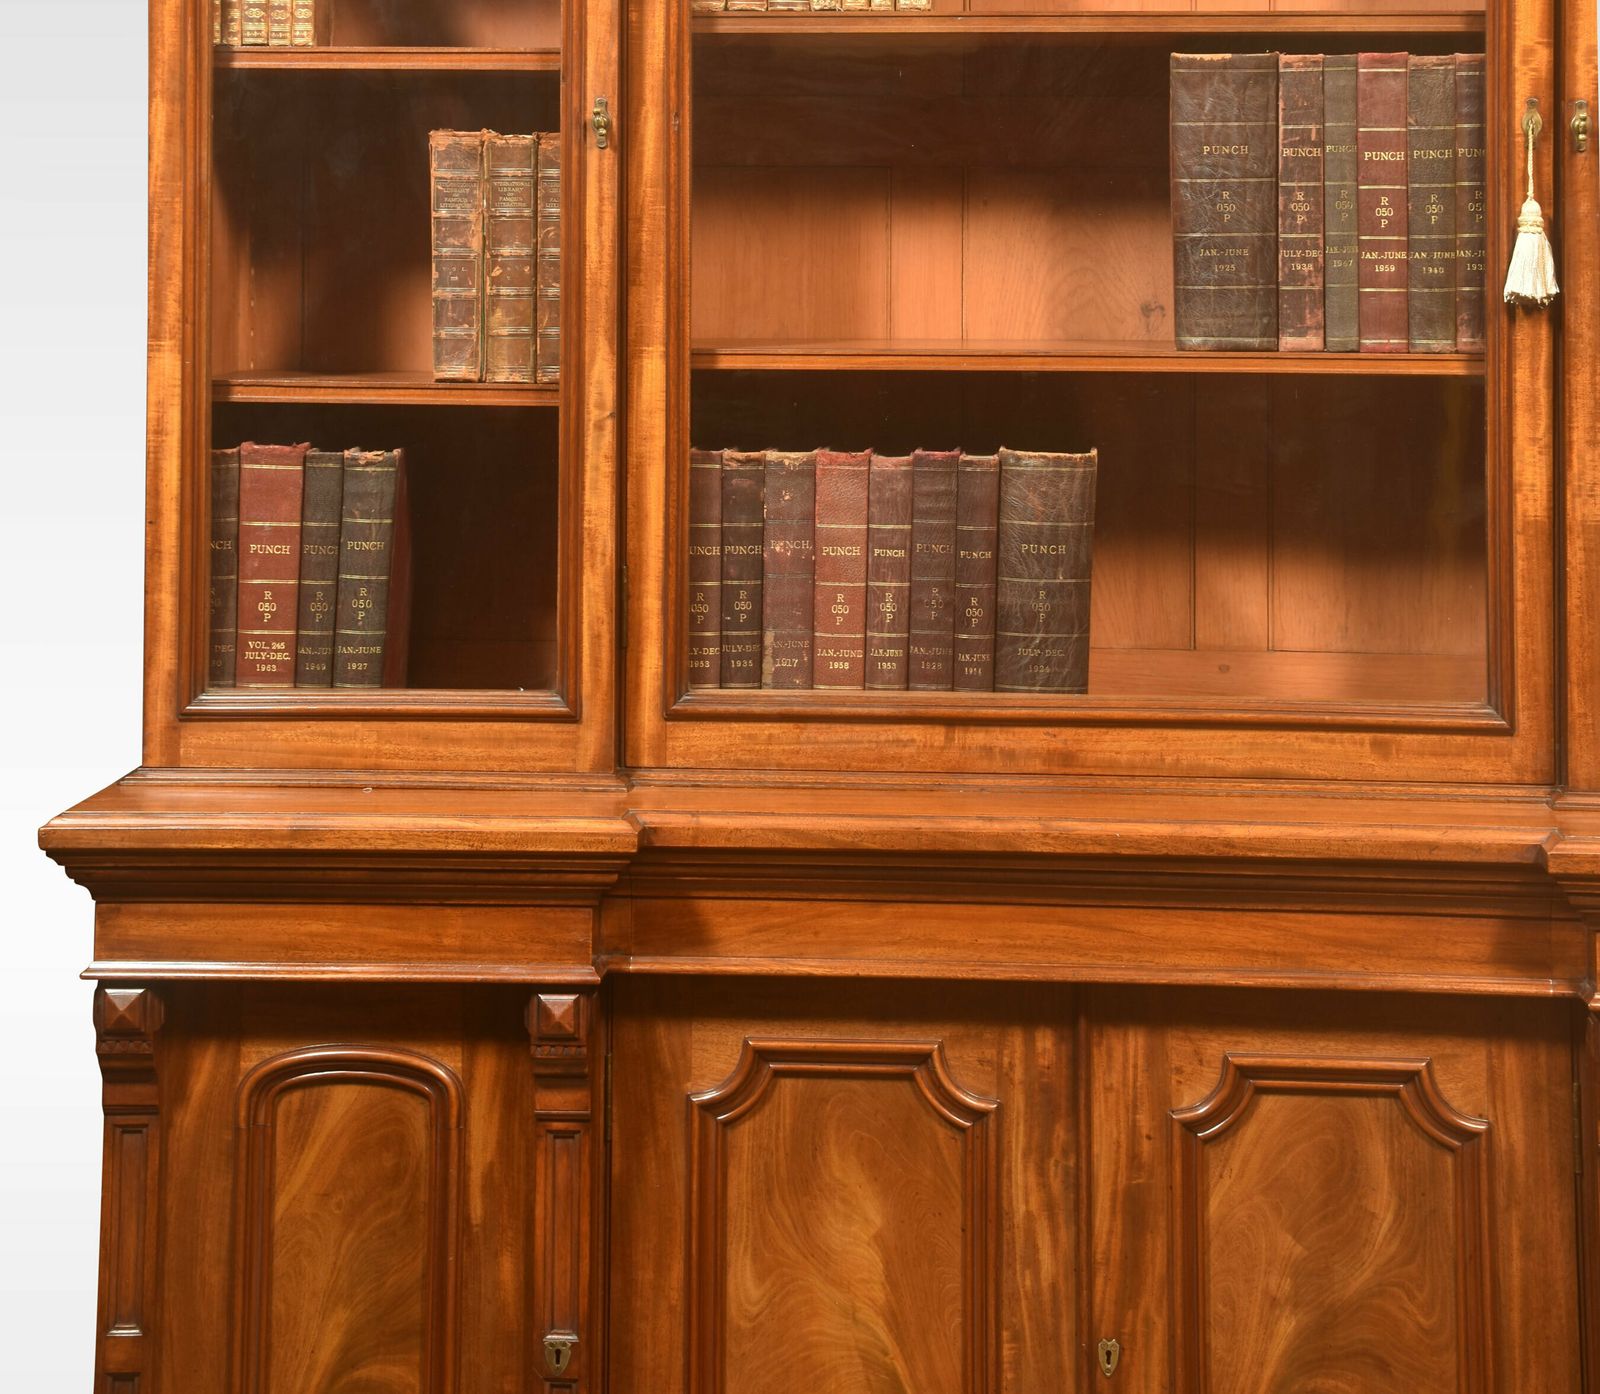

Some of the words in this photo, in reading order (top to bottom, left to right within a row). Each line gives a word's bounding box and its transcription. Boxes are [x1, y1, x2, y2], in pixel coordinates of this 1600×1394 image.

[1203, 145, 1249, 155] PUNCH
[1282, 147, 1321, 157] PUNCH
[1413, 149, 1453, 159] PUNCH
[1364, 151, 1405, 161] PUNCH
[1222, 191, 1231, 200] R
[1296, 191, 1305, 201] R
[1340, 190, 1349, 199] R
[1430, 194, 1439, 203] R
[1475, 190, 1483, 200] R
[1335, 201, 1353, 210] 050
[1380, 197, 1389, 206] R
[1216, 203, 1236, 212] 050
[1291, 202, 1310, 212] 050
[1424, 205, 1444, 214] 050
[1341, 213, 1349, 221] P
[1375, 208, 1394, 217] 050
[1223, 214, 1231, 222] P
[1296, 215, 1304, 223] P
[1431, 216, 1439, 225] P
[1475, 214, 1483, 223] P
[1380, 219, 1389, 228] P
[1360, 251, 1407, 259] JAN.-JUNE
[1375, 264, 1396, 272] 1959
[250, 544, 291, 555] PUNCH
[347, 541, 385, 551] PUNCH
[725, 545, 762, 555] PUNCH
[1021, 544, 1066, 554] PUNCH
[689, 546, 721, 556] UNCH
[822, 546, 861, 556] PUNCH
[874, 548, 905, 558] PUNCH
[960, 550, 992, 559] PUNCH
[264, 590, 273, 600] R
[316, 591, 324, 600] R
[359, 587, 368, 596] R
[739, 590, 748, 599] R
[1039, 590, 1047, 600] R
[696, 592, 705, 601] R
[837, 593, 845, 602] R
[885, 592, 893, 602] R
[352, 599, 373, 609] 050
[734, 601, 752, 610] 050
[971, 597, 979, 606] R
[257, 602, 277, 612] 050
[310, 602, 328, 612] 050
[690, 604, 709, 614] 050
[831, 604, 849, 614] 050
[880, 602, 898, 612] 050
[1031, 602, 1050, 612] 050
[263, 613, 272, 622] P
[358, 612, 366, 620] P
[931, 611, 938, 620] P
[965, 608, 983, 618] 050
[315, 614, 323, 622] P
[697, 616, 705, 624] P
[740, 614, 748, 622] P
[836, 616, 844, 625] P
[885, 613, 894, 623] P
[1039, 614, 1046, 623] P
[971, 619, 979, 628] P
[248, 641, 270, 650] VOL.
[271, 641, 286, 650] 245
[772, 640, 810, 648] AN.-JUNE
[337, 645, 382, 654] JAN.-JUNE
[817, 648, 864, 658] JAN.-JUNE
[870, 648, 903, 657] JAN.-JUNE
[244, 651, 291, 660] JULY-DEC.
[256, 663, 278, 672] 1963
[347, 662, 368, 670] 1927
[690, 660, 710, 668] 1953
[829, 661, 849, 670] 1958
[877, 662, 897, 670] 1953
